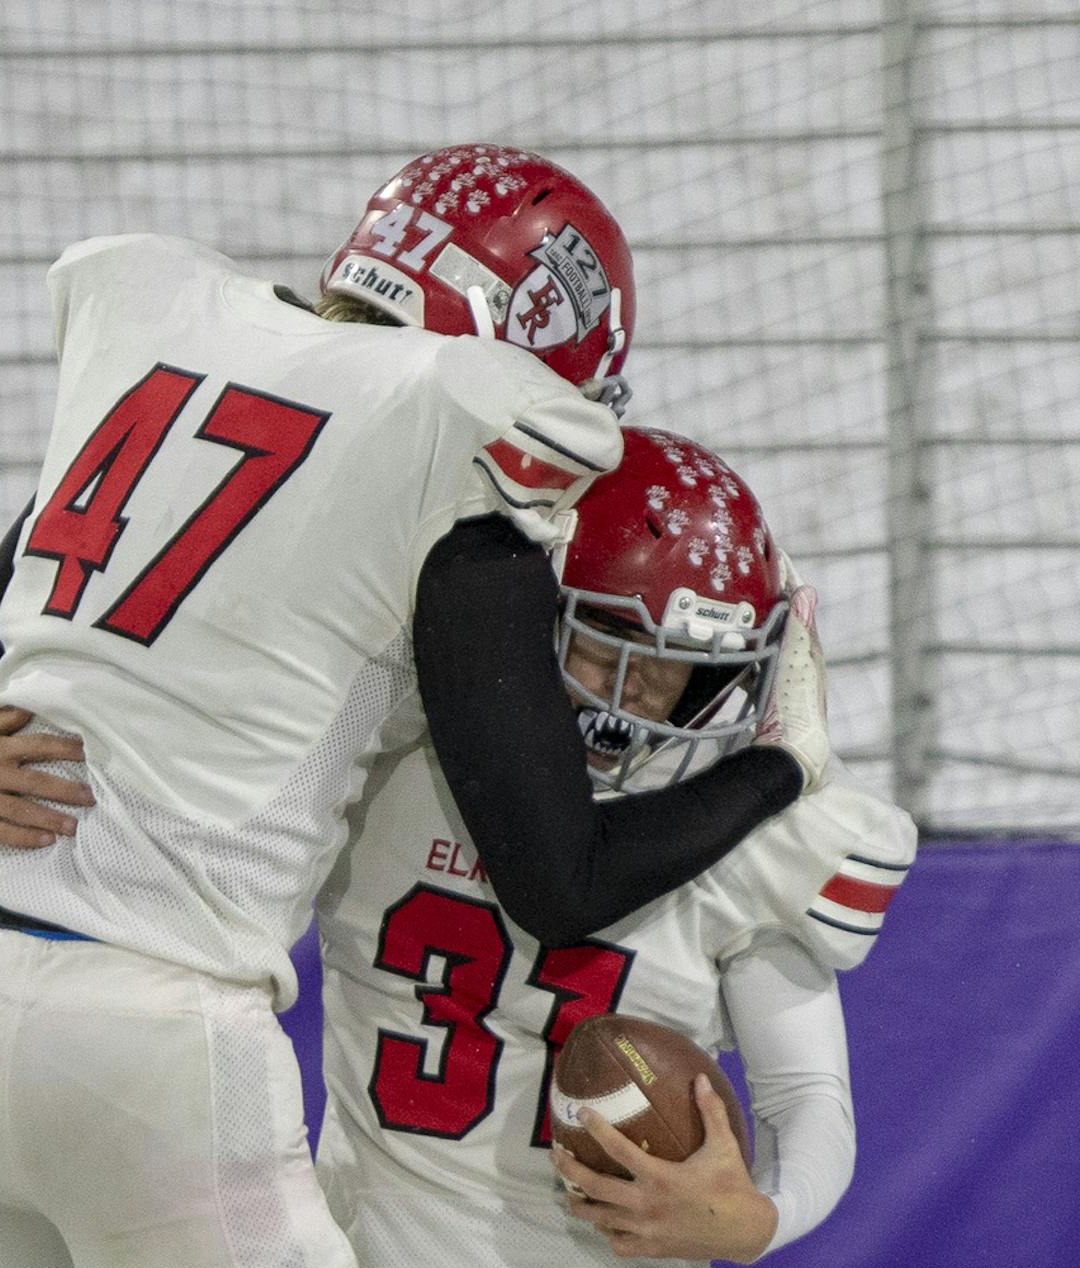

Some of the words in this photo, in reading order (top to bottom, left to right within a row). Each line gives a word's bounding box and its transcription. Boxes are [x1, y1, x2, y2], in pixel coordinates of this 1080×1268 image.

[370, 202, 455, 272] 47
[562, 232, 608, 297] 127
[561, 261, 591, 309] FOOTBALL
[22, 361, 333, 648] 47
[696, 607, 730, 622] schutt
